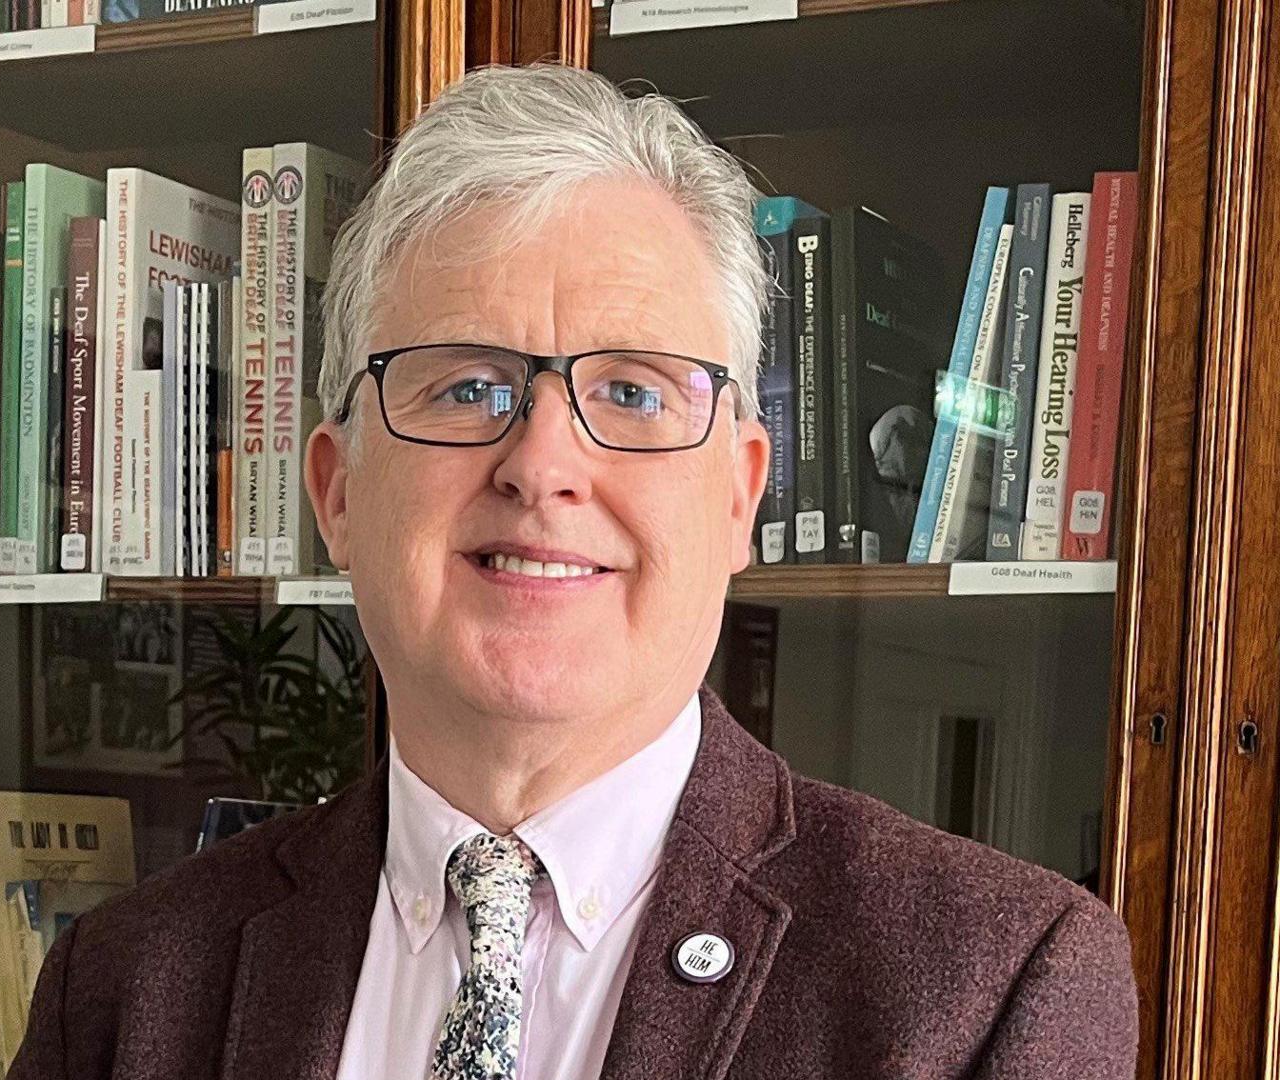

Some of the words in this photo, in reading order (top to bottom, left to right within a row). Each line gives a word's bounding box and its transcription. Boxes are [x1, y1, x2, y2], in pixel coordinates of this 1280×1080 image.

[1060, 203, 1084, 270] Helleberg
[75, 272, 90, 303] The
[256, 240, 268, 308] HISTORY
[284, 242, 297, 311] HISTORY
[73, 306, 90, 348] Deaf
[1054, 275, 1084, 329] Your
[70, 348, 89, 390] Sport
[272, 334, 295, 456] TENNIS
[1042, 331, 1078, 425] Hearing
[114, 399, 125, 433] DEAF
[244, 336, 266, 456] TENNIS
[71, 395, 88, 479] Movement
[1041, 428, 1070, 480] Loss
[70, 480, 84, 495] in
[113, 436, 124, 504] FOOTBALL
[1036, 498, 1055, 507] HEL
[991, 567, 1010, 577] G08
[1012, 568, 1037, 577] Deaf
[1038, 570, 1073, 580] Health
[684, 952, 712, 973] HIM
[700, 939, 719, 956] HE
